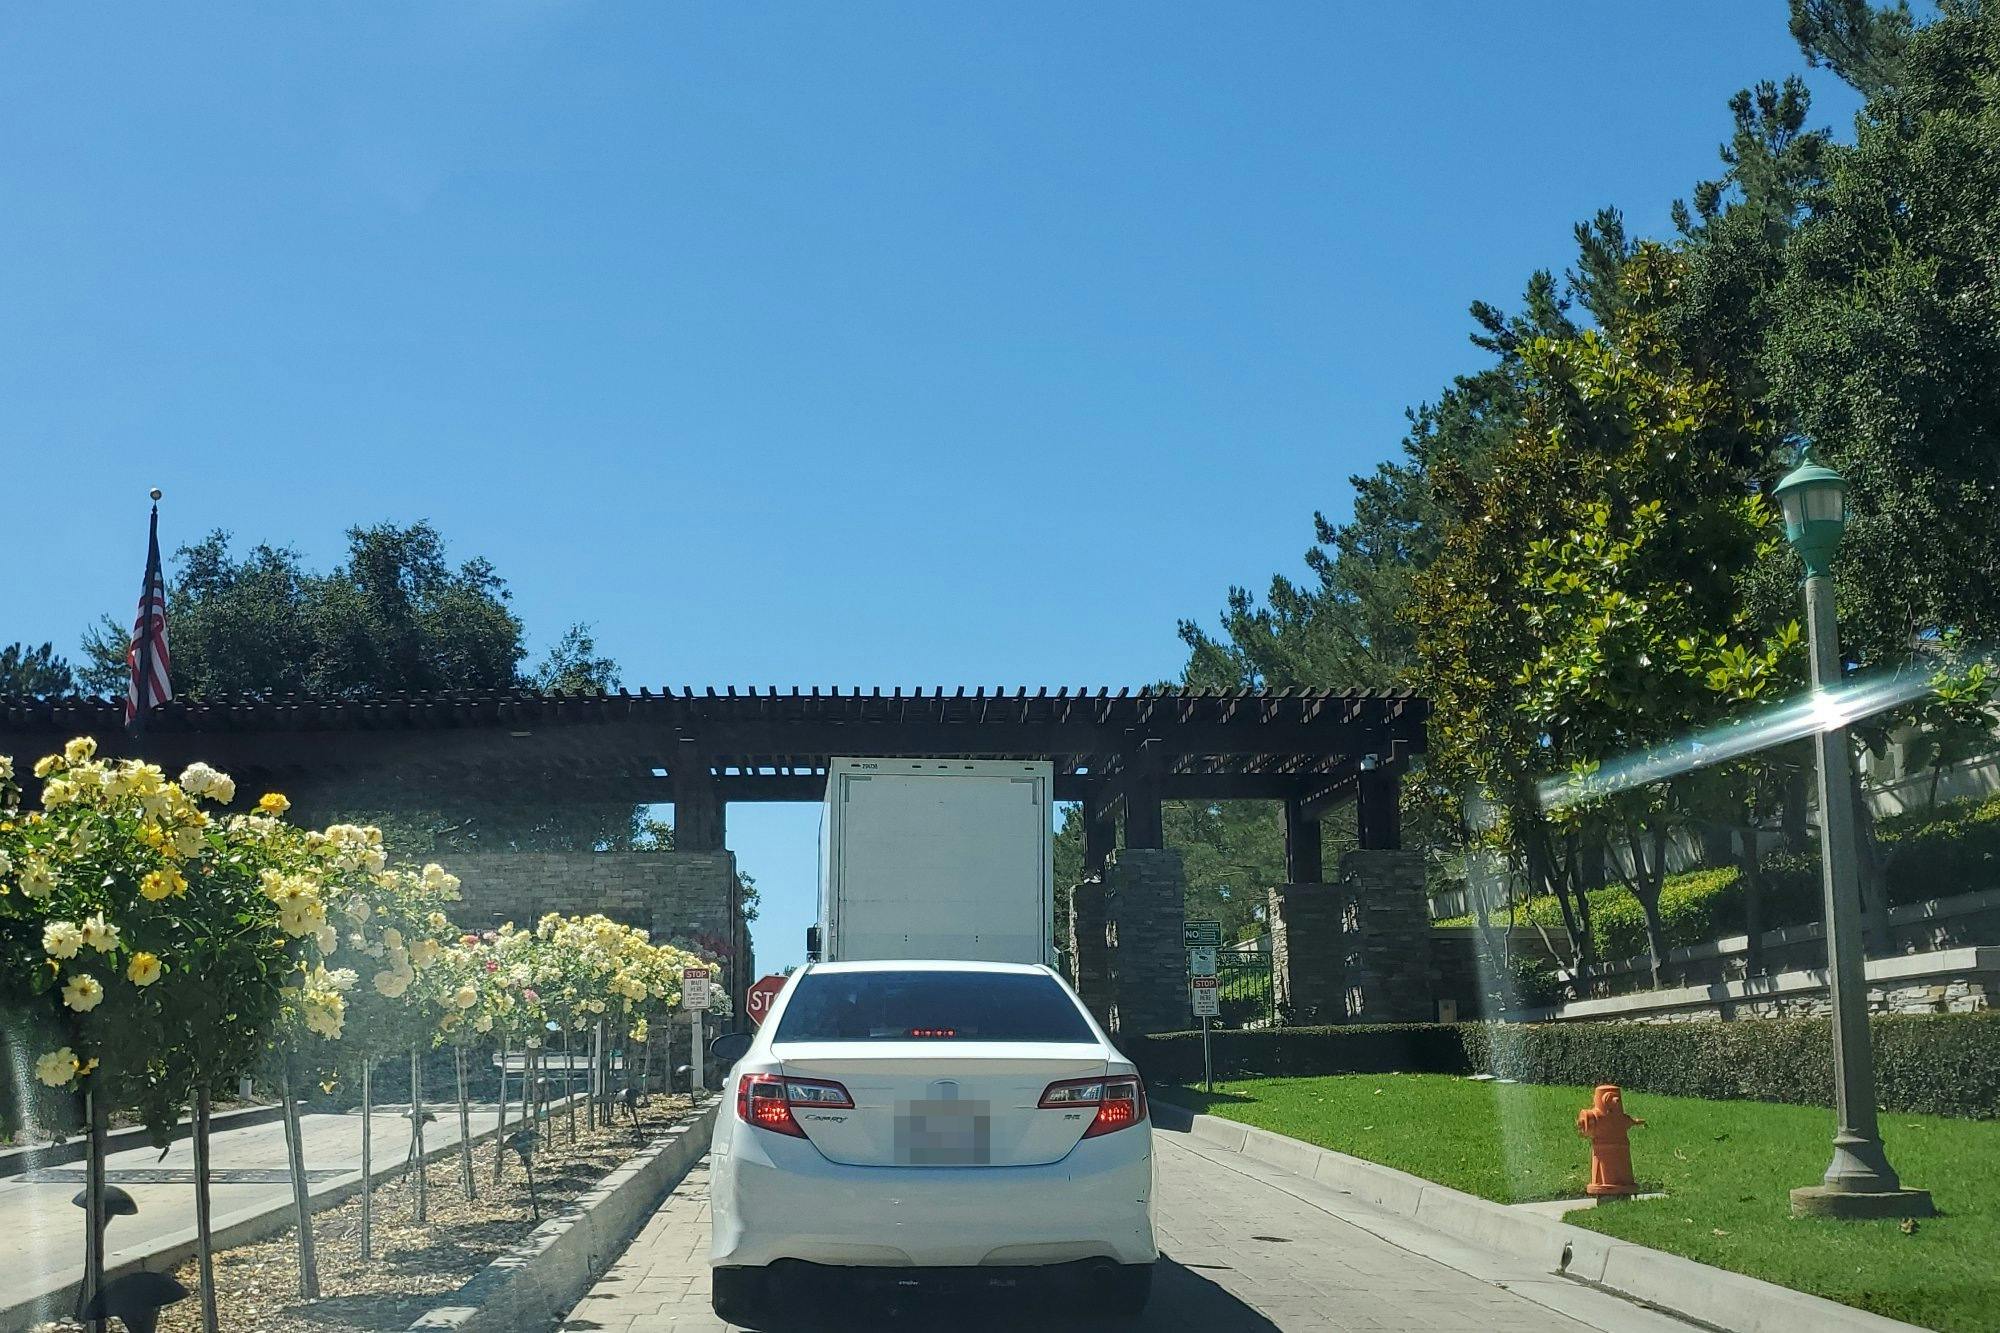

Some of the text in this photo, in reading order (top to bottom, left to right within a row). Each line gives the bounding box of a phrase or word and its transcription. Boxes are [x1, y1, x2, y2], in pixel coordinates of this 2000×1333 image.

[1185, 930, 1199, 939] NO
[686, 970, 707, 978] STOP
[1195, 980, 1215, 988] STOP
